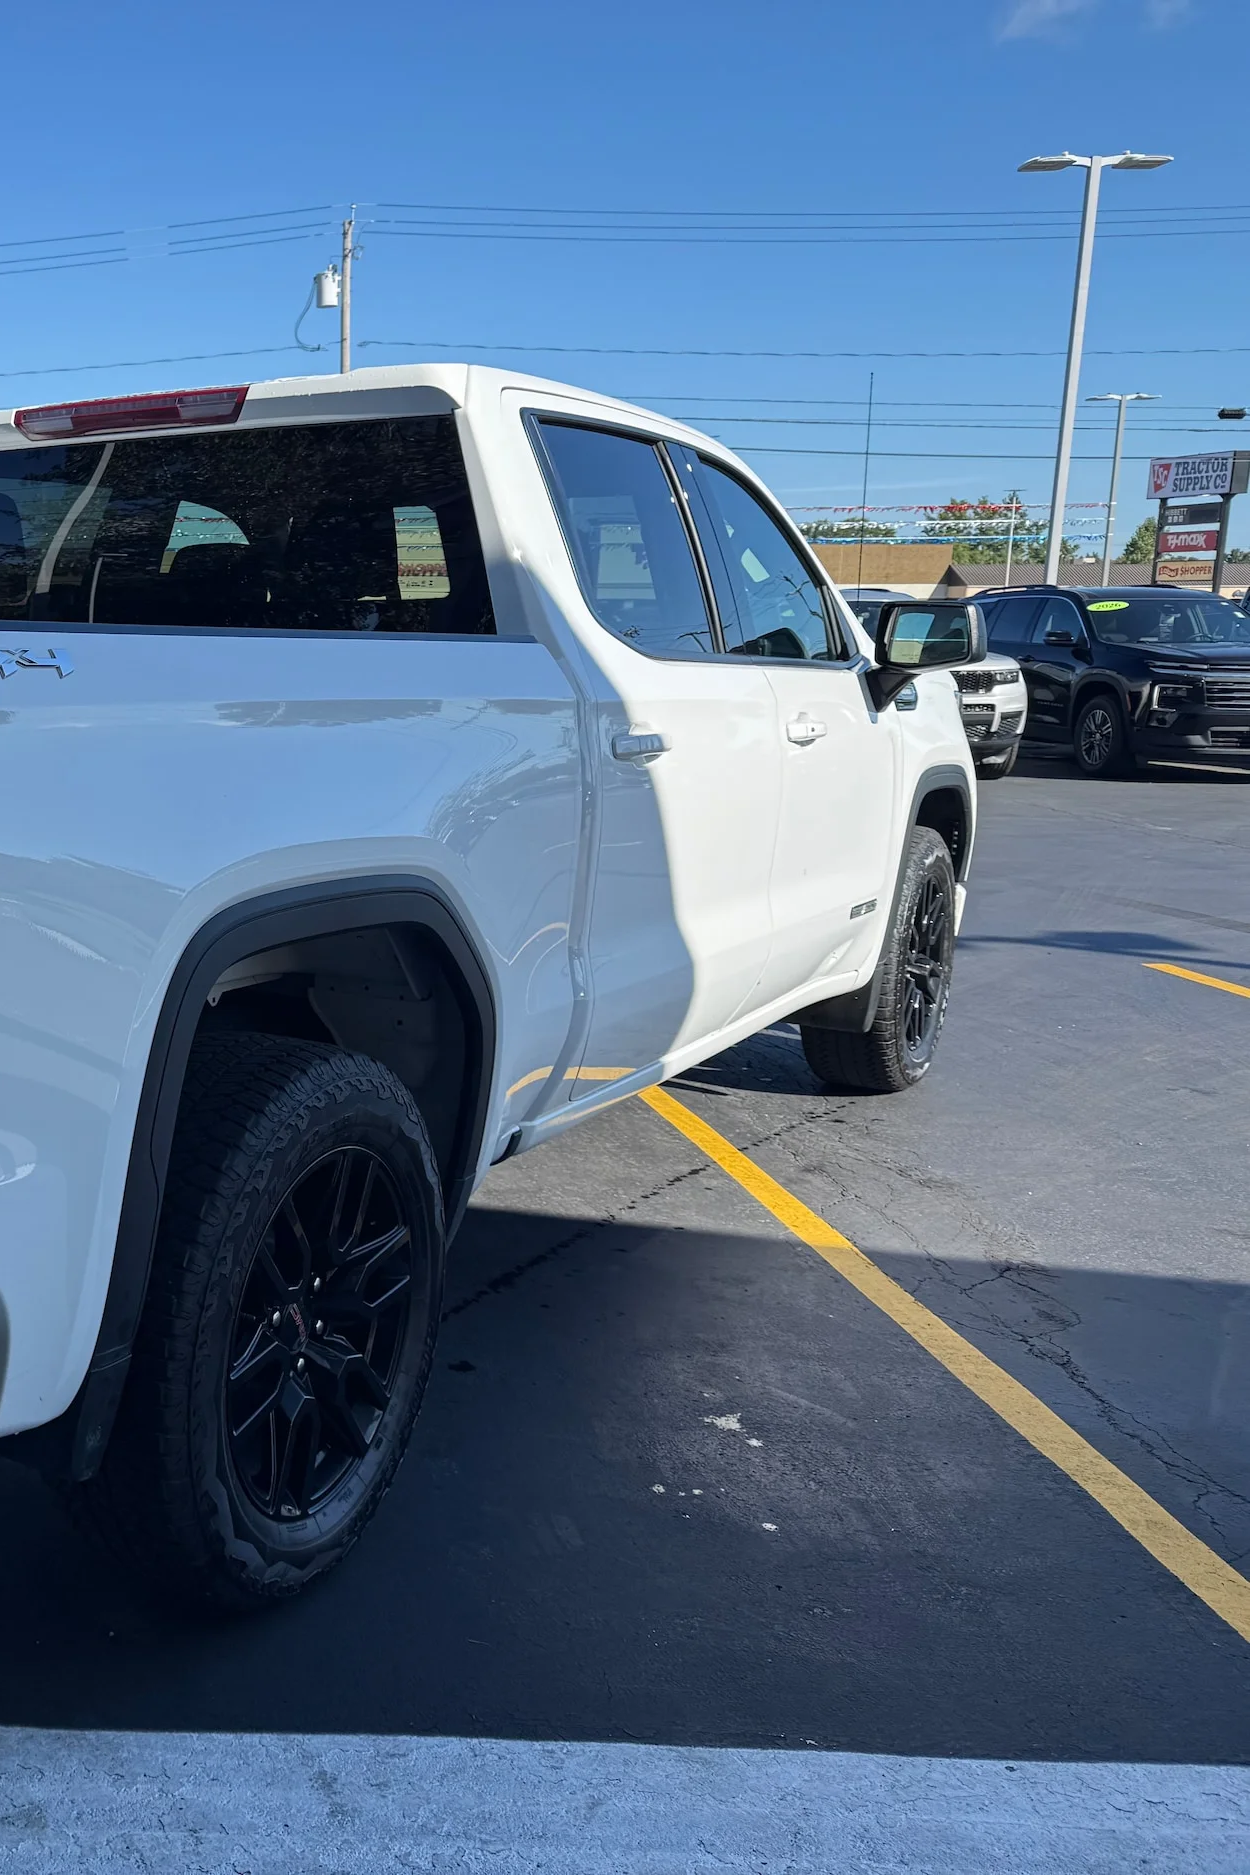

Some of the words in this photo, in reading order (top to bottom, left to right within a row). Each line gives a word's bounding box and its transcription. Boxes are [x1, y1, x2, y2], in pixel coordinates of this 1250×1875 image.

[1153, 465, 1168, 487] TSC
[1174, 458, 1228, 477] TRACTOR
[1172, 474, 1213, 493] SUPPLY
